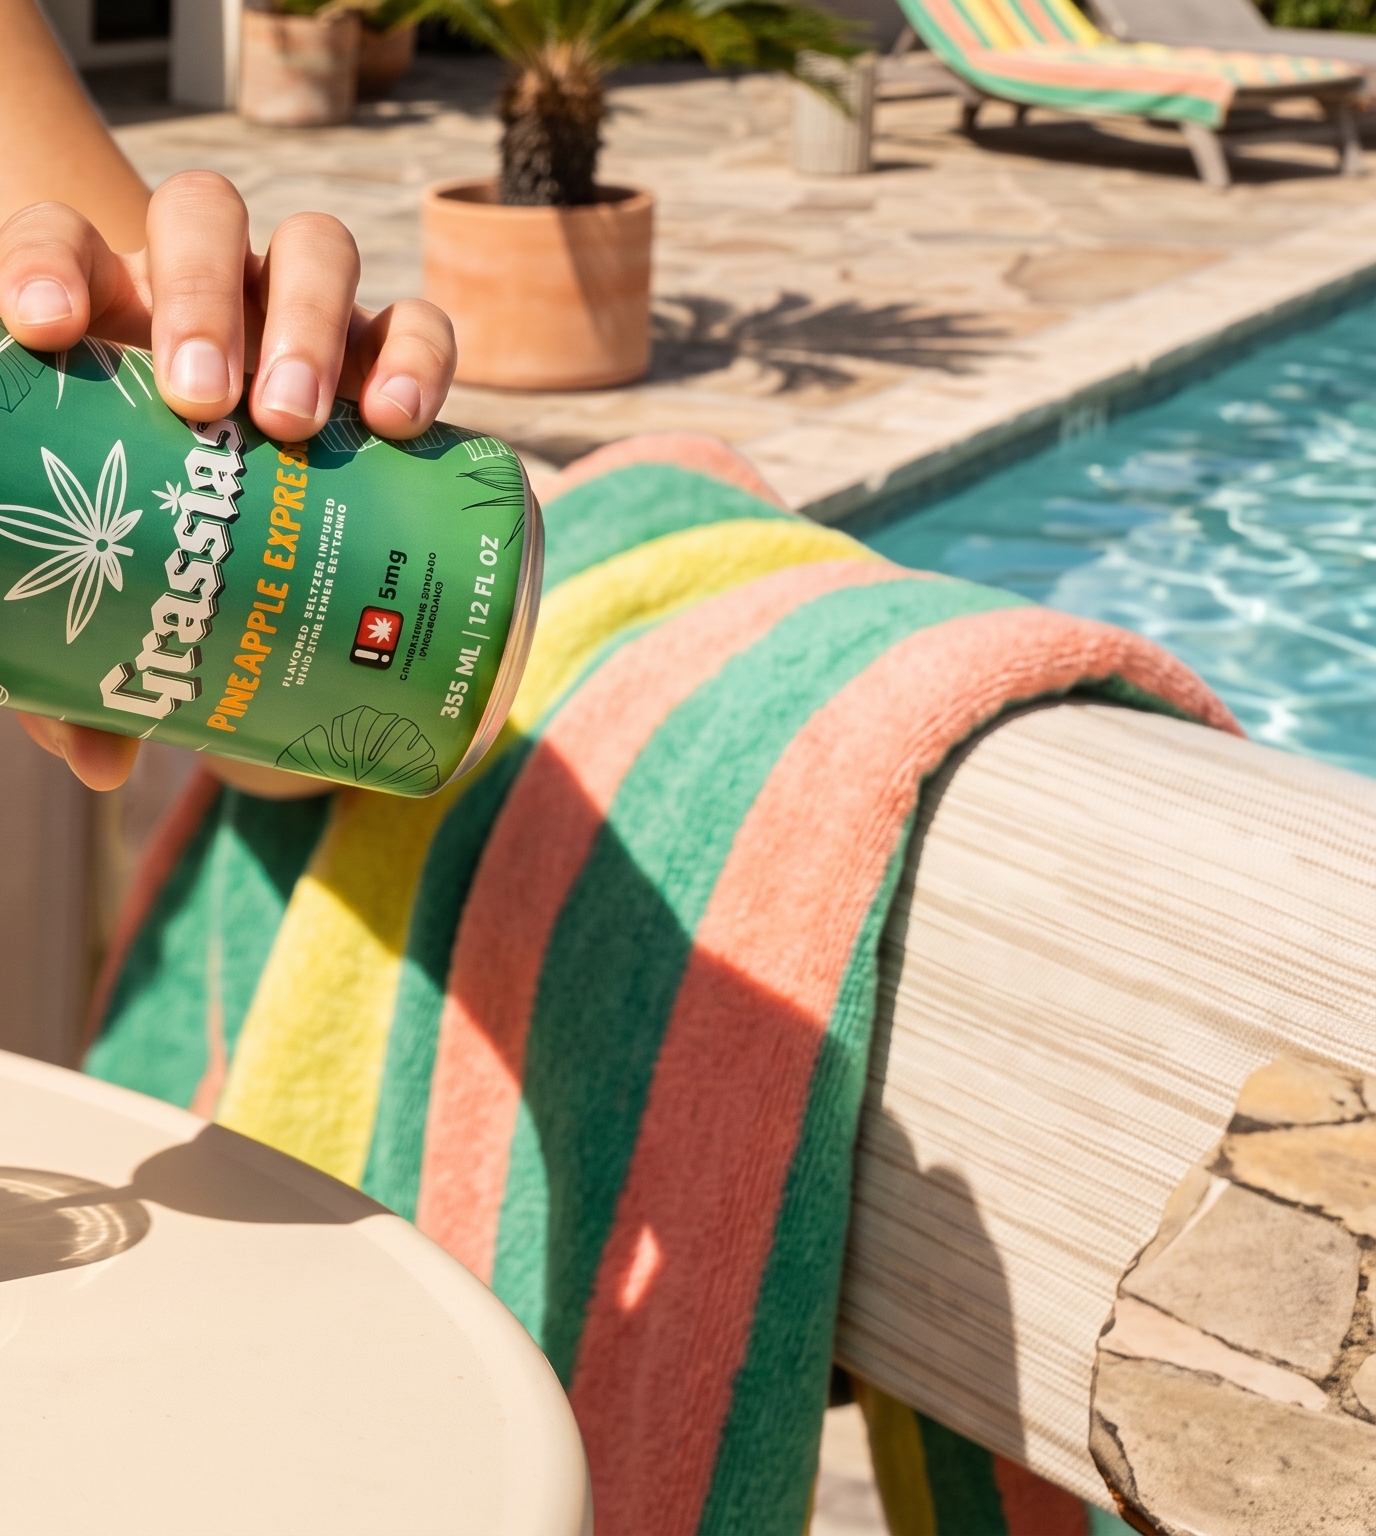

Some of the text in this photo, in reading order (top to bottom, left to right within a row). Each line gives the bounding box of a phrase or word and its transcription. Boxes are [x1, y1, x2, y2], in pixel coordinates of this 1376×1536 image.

[479, 534, 499, 566] OZ
[378, 549, 408, 600] 5mg
[474, 573, 495, 597] FL
[282, 625, 309, 687] FLAVORED
[304, 560, 326, 619] SELTZER
[318, 498, 335, 557] INFUSED
[468, 601, 490, 625] 12
[206, 578, 289, 732] PINEAPPLE
[455, 645, 481, 676] ML
[440, 680, 469, 719] 355
